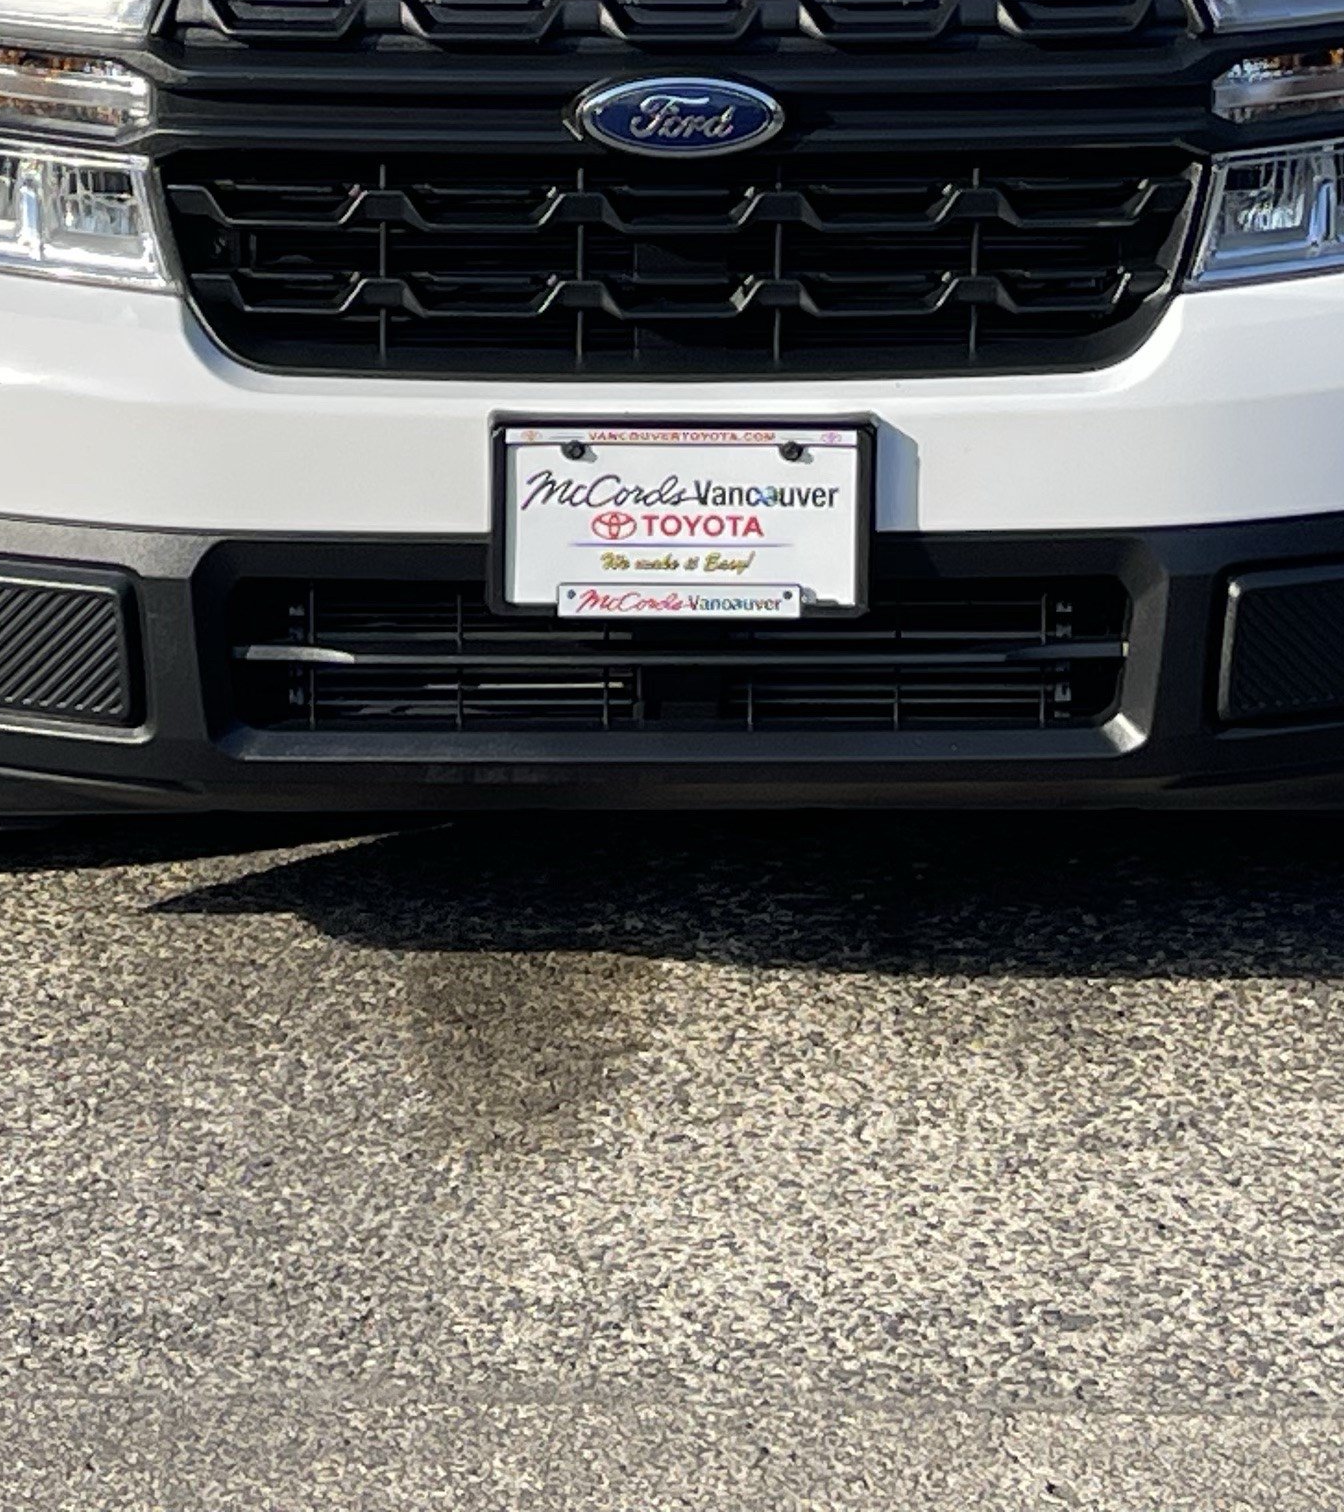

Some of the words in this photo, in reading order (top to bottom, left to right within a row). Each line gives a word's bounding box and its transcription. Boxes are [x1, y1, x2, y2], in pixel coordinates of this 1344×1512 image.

[630, 95, 737, 139] Ford
[643, 515, 765, 537] TOYOTA
[601, 551, 630, 570] We
